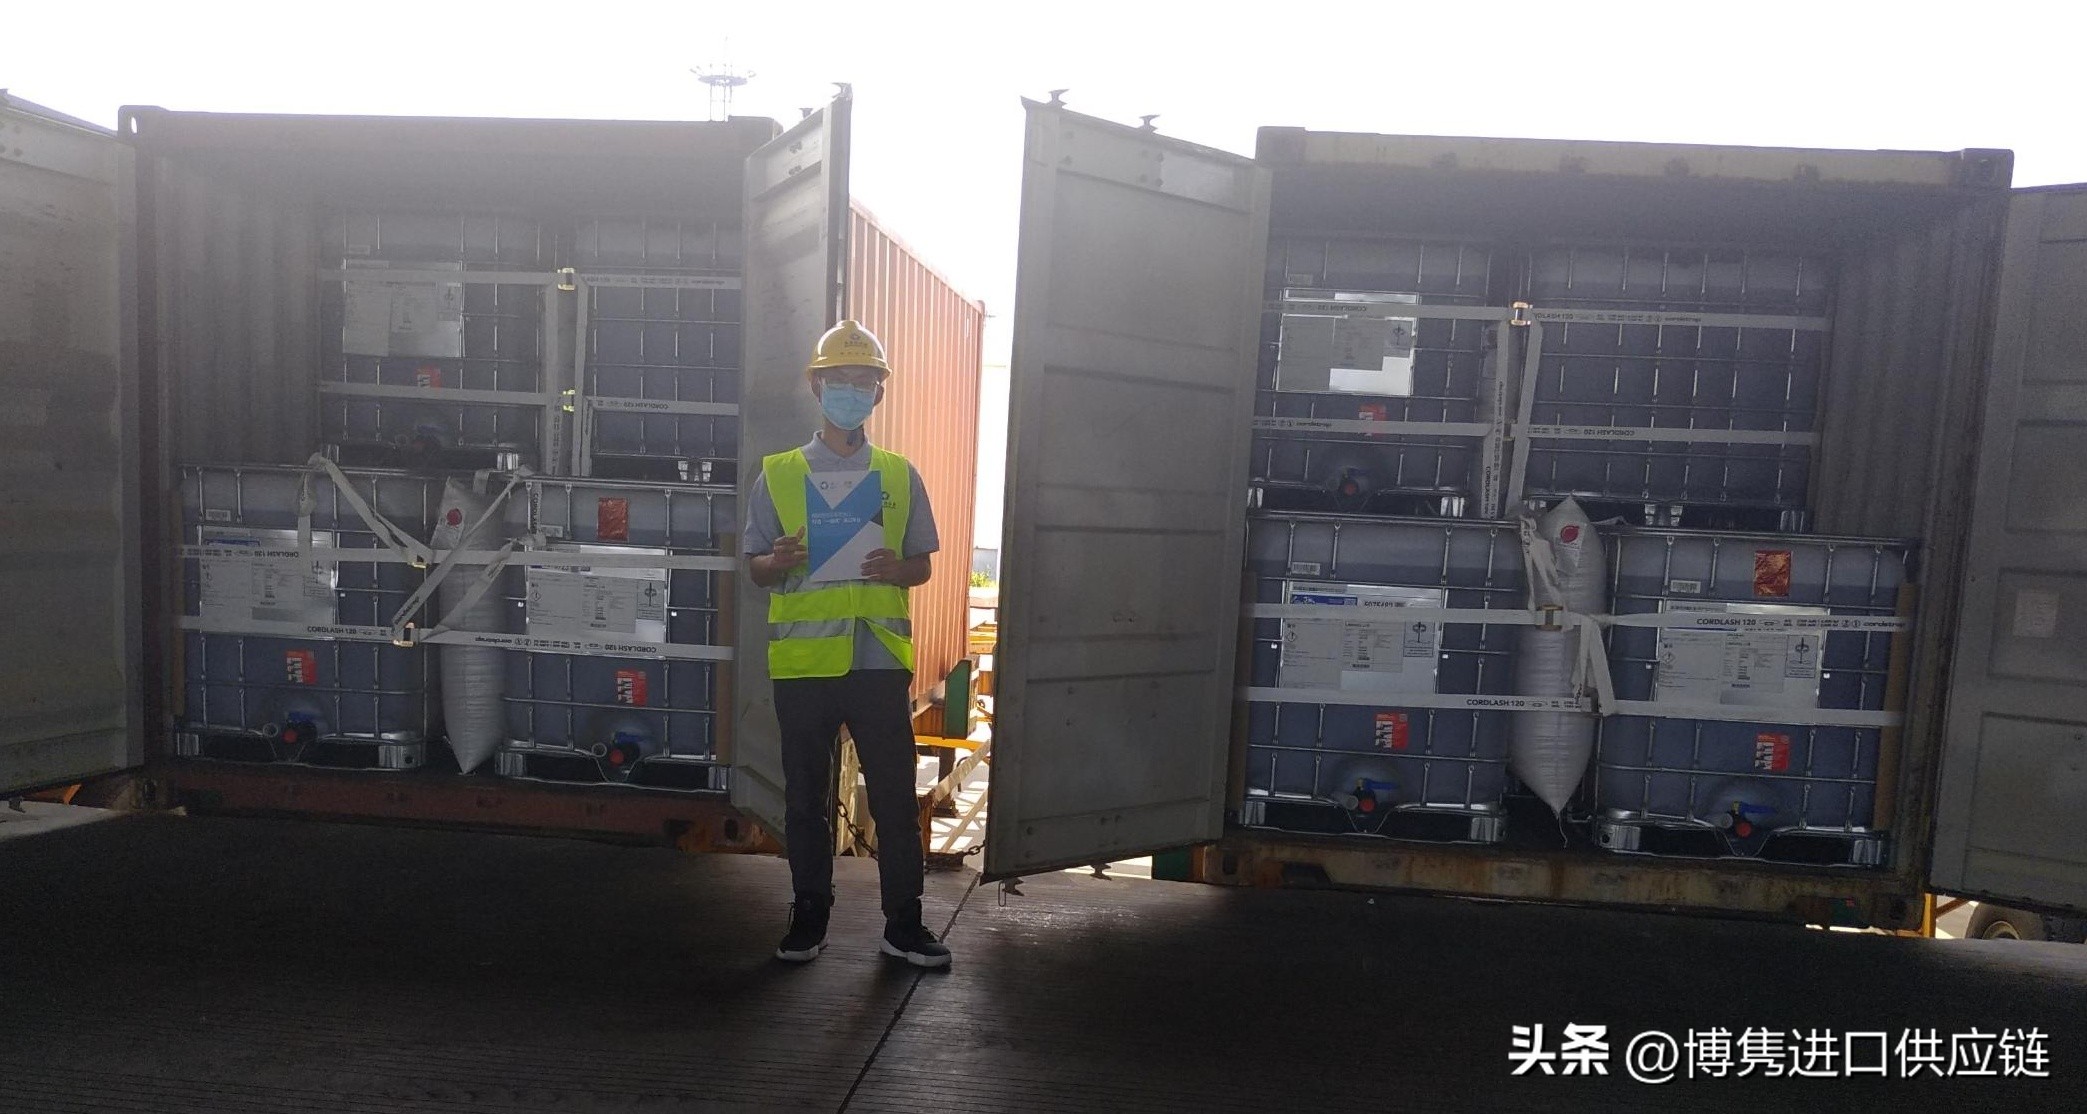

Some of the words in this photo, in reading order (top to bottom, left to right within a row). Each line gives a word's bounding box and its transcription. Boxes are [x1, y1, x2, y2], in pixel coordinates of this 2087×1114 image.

[1696, 618, 1741, 626] CORDLASH
[1742, 618, 1757, 626] 120
[307, 626, 344, 634] CORDLASH
[604, 643, 617, 651] 120
[618, 644, 657, 653] CORDLASH
[1466, 699, 1510, 707] CORDLASH
